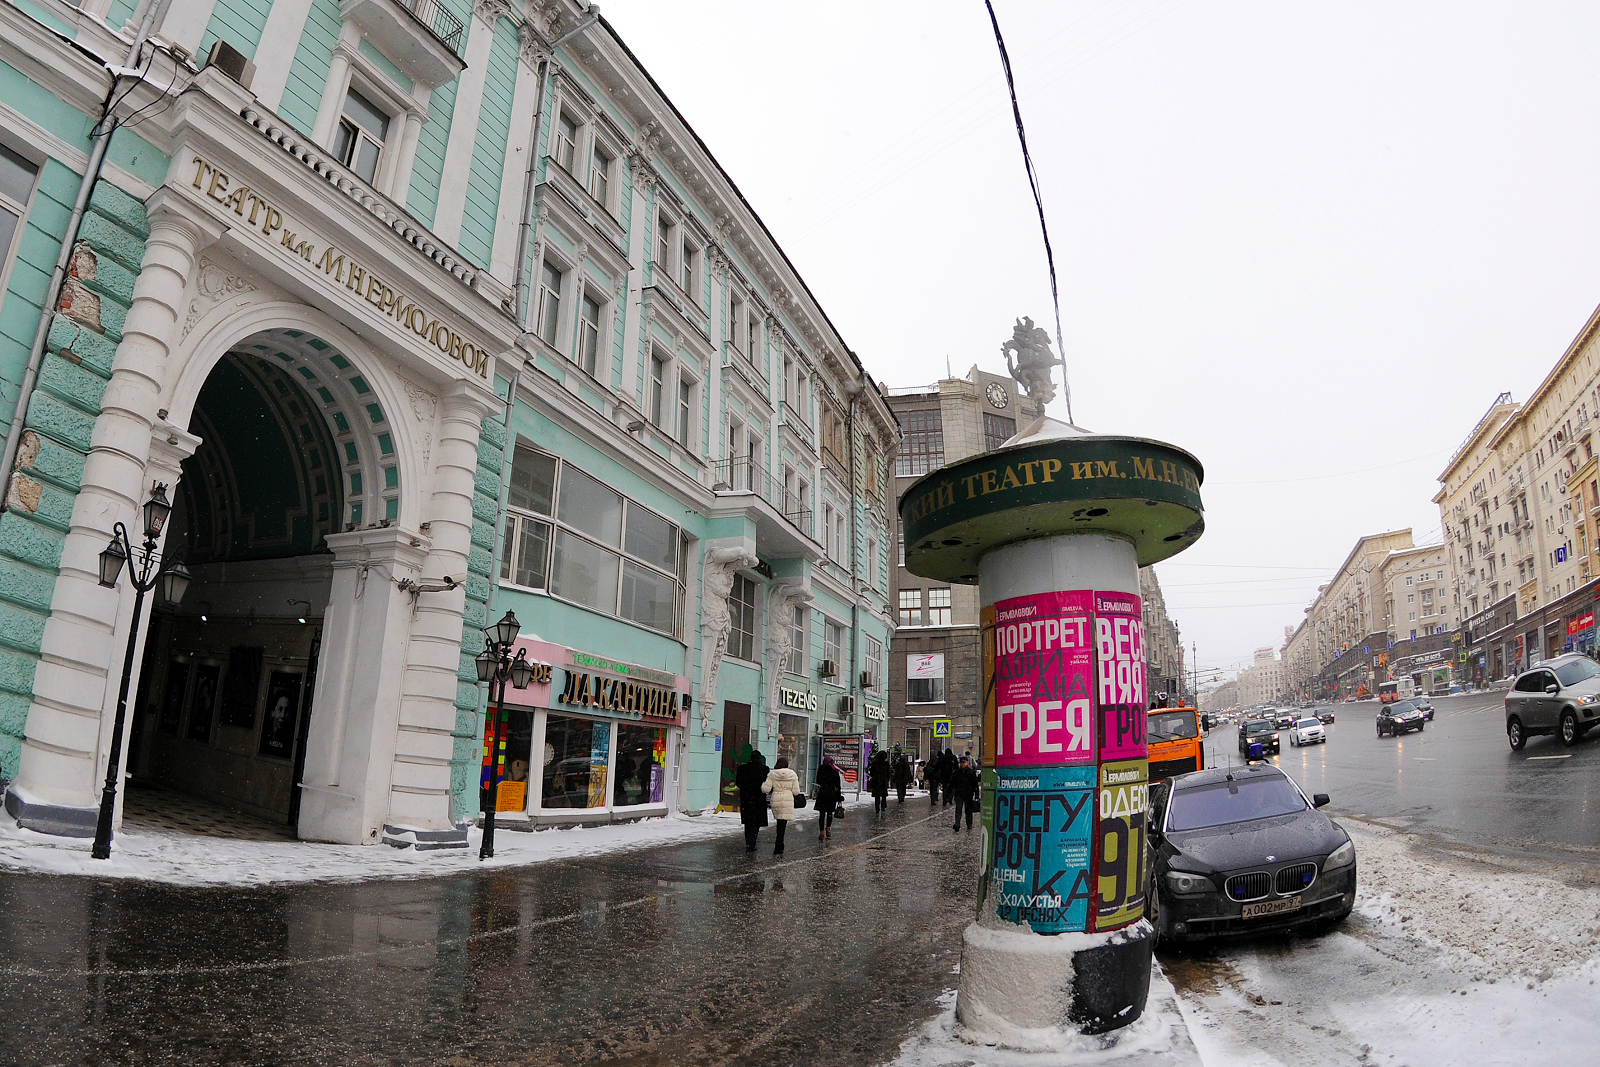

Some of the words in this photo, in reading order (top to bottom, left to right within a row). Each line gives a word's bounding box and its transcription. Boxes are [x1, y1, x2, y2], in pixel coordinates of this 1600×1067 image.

[193, 156, 283, 236] ТЕАТР
[961, 458, 1063, 500] ТЕАТР
[1070, 460, 1127, 480] им.
[996, 617, 1087, 656] ПОРТРЕТ
[998, 648, 1062, 682] ДОРИ
[1099, 661, 1143, 704] НЯЯ
[560, 671, 593, 707] ЛА
[596, 677, 680, 719] КАНТИНА
[780, 686, 818, 711] TEZENIS
[1031, 673, 1090, 702] АНА
[864, 703, 886, 721] TEZENIS
[997, 698, 1090, 756] ГРЕЯ
[996, 793, 1092, 832] СНЕГУ
[994, 832, 1042, 871] РОЧ
[1096, 812, 1146, 917] 91
[1017, 906, 1070, 923] ПЕСНЯХ
